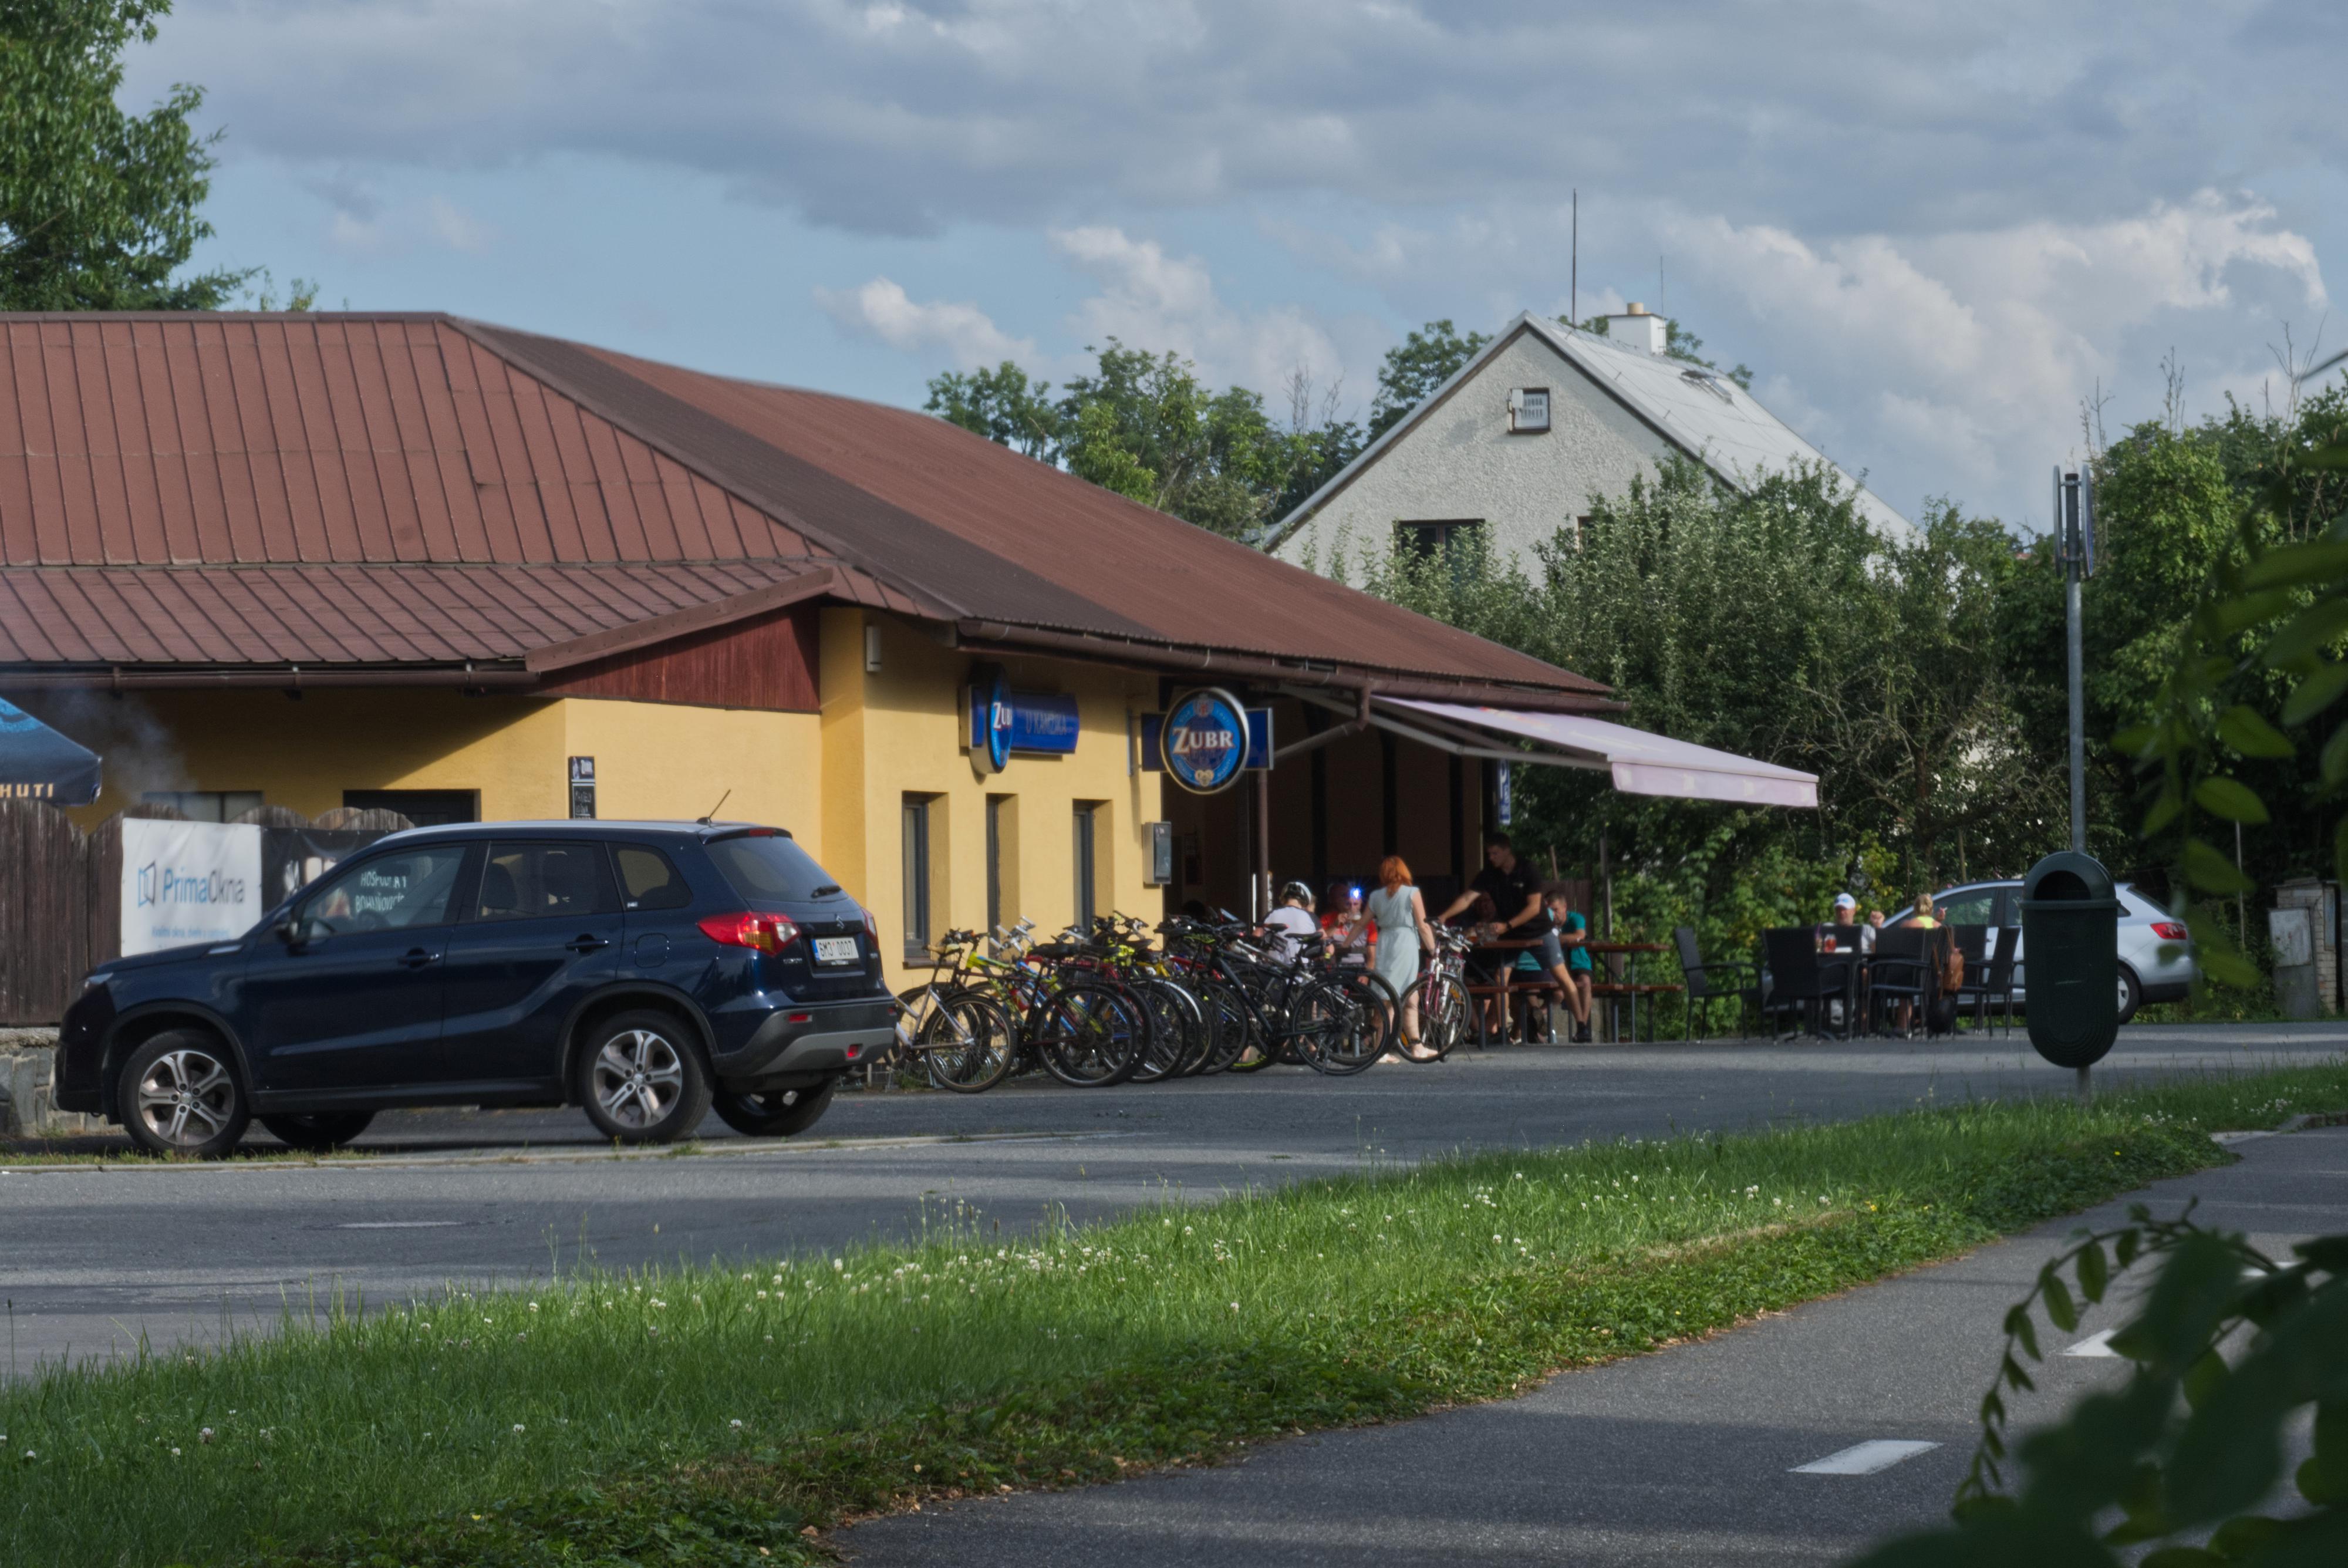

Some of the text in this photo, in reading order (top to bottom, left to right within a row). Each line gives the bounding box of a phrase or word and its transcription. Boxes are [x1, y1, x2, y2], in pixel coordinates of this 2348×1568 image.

[993, 702, 1013, 729] ZUB
[1172, 726, 1235, 754] ZUBR
[0, 783, 54, 798] HUTI
[163, 865, 245, 903] PrimaOkna
[819, 940, 853, 957] 6M3 0037
